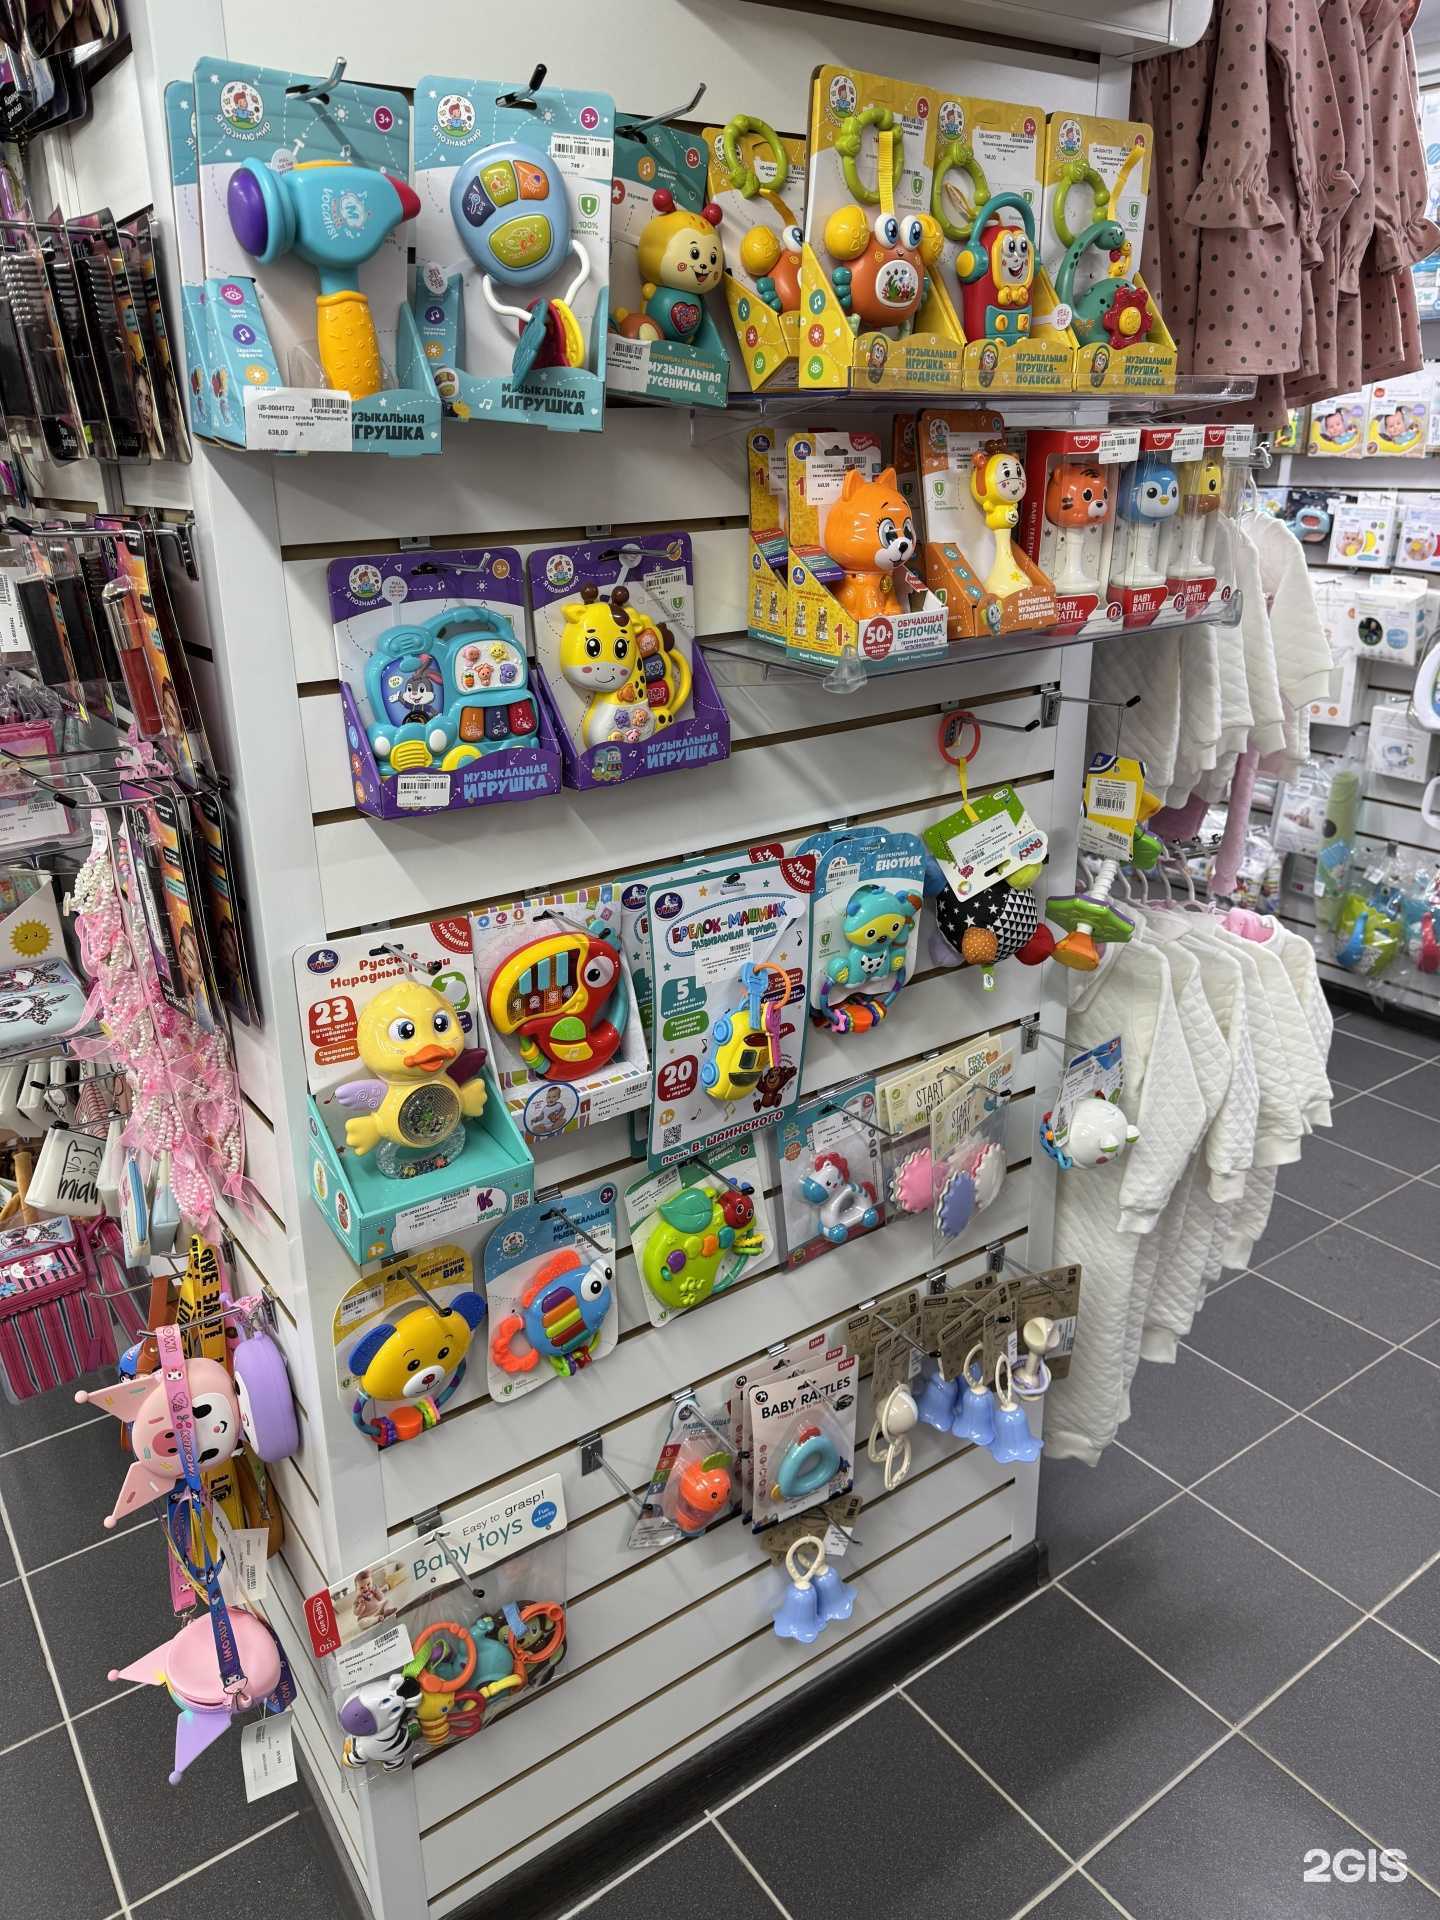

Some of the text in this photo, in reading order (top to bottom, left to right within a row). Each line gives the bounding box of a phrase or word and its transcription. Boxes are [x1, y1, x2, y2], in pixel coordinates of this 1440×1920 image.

[377, 112, 391, 124] 3+
[584, 112, 596, 124] 3+
[905, 347, 957, 360] МУЗЫКАЛЬНАЯ
[1016, 352, 1068, 364] МУЗЫКАЛЬНАЯ
[1125, 354, 1172, 366] МУЗЫКАЛЬНАЯ
[905, 370, 950, 382] ПОДВЕСКА
[1015, 362, 1057, 374] ИГРУШКА-
[1124, 365, 1163, 376] ИГРУШКА-
[1015, 373, 1061, 386] ПОДВЕСКА
[1124, 375, 1166, 386] ПОДВЕСКА
[502, 383, 586, 400] МЗЫКАЛЬНАЯ
[502, 395, 585, 415] ИГРУШКА
[352, 411, 425, 424] УЗЫКАЛЬНАЯ
[352, 425, 425, 441] ГРУШКА
[1186, 584, 1203, 594] BABY
[1186, 591, 1206, 603] RATTLE
[1133, 593, 1151, 603] BABY
[1132, 601, 1156, 613] RATTLE
[897, 614, 944, 628] ОБУЧАЮЩАЯ
[866, 624, 893, 645] 50+
[897, 623, 943, 640] БЕЛОЧКА
[647, 732, 719, 754] МУЗЫКАЛЬНАЯ
[647, 742, 719, 769] ИГРУШКА
[463, 763, 548, 783] МУЗЫКАЛЬНАЯ
[463, 774, 548, 800] ИГРУШКА
[793, 862, 812, 877] ХИТ
[875, 854, 922, 872] ЕНОТИК
[671, 901, 788, 944] БРЕЛОК-МАШИНК
[691, 923, 777, 951] РАЗВИВАЮЩАЯ ИГРУШКА
[358, 952, 419, 970] Русске
[330, 967, 405, 989] Народные
[676, 978, 690, 1000] 5
[314, 999, 349, 1027] 23
[663, 1060, 693, 1087] 20
[916, 1079, 944, 1108] START
[952, 1099, 972, 1127] START
[691, 1141, 704, 1153] В.
[442, 1263, 465, 1279] ВИК
[761, 1397, 797, 1419] BABY
[462, 1489, 546, 1537] Easy to grasp!
[413, 1518, 524, 1581] Baby toys
